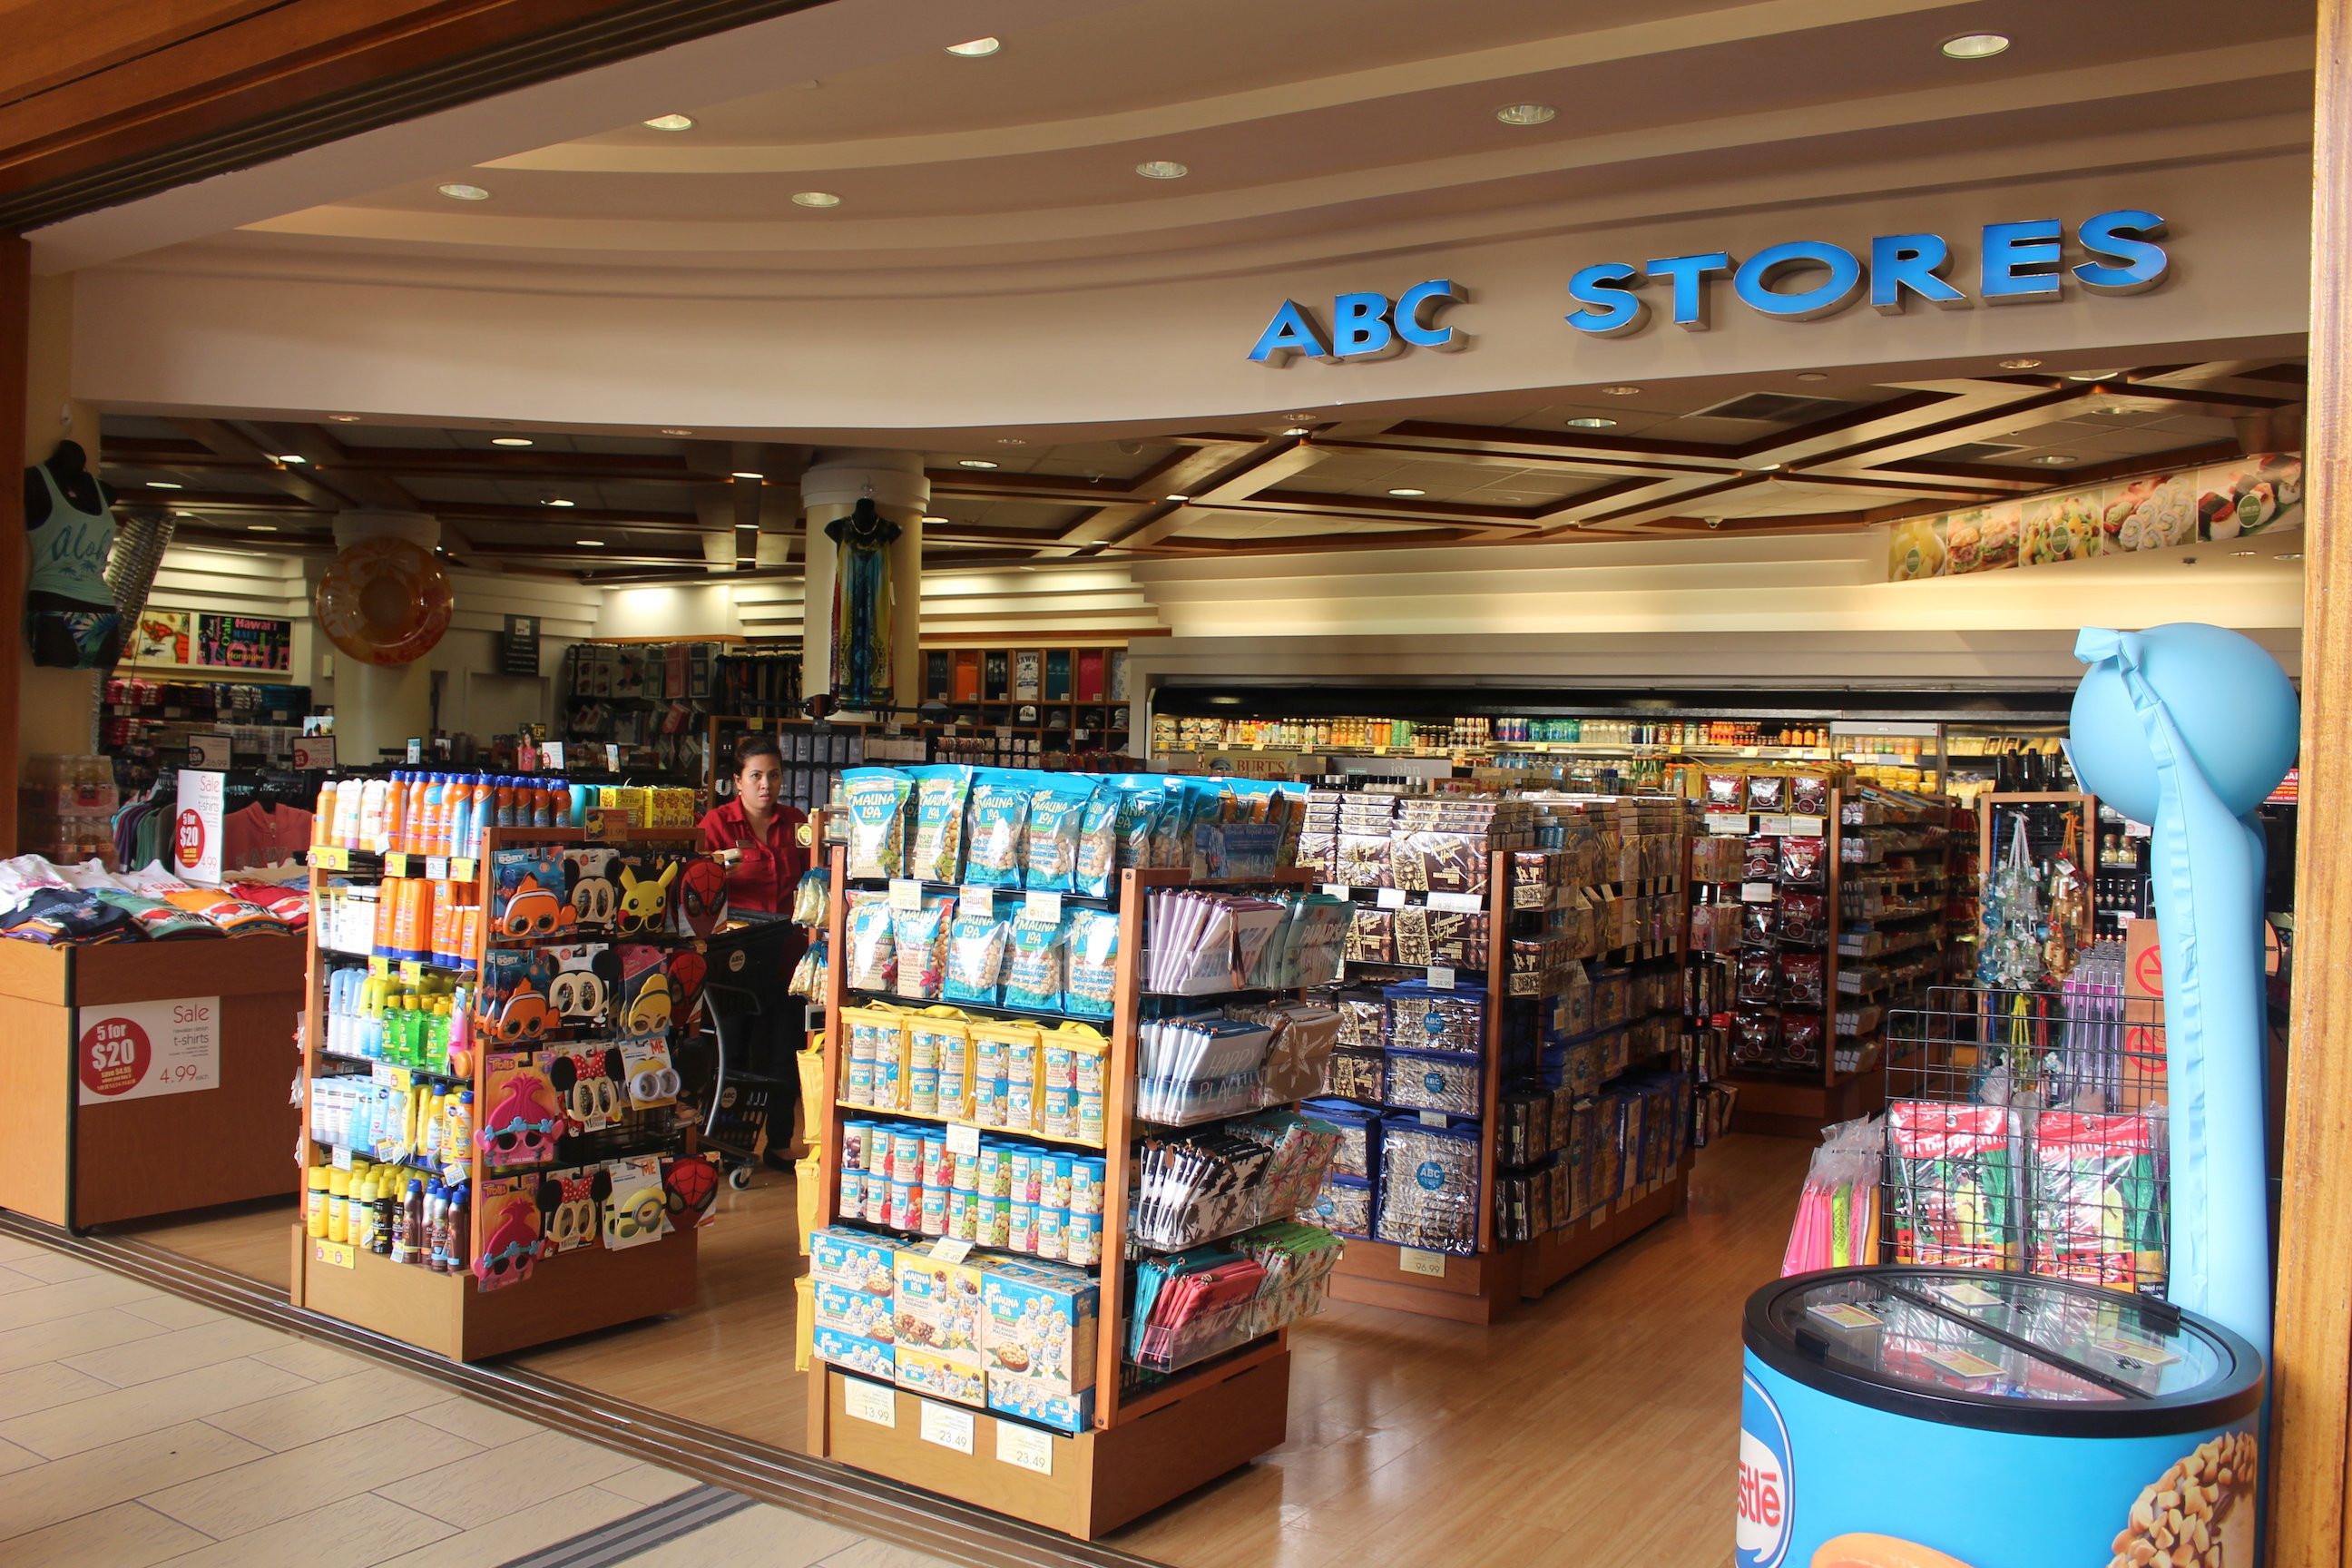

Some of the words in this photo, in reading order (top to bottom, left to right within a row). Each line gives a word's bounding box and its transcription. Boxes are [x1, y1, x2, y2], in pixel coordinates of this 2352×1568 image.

[1247, 278, 1472, 366] ABC
[1563, 210, 2171, 338] STORES
[1237, 760, 1285, 773] BURT'S
[1390, 762, 1421, 776] john
[201, 775, 220, 792] Sale
[853, 793, 895, 806] MAUNA
[922, 795, 953, 806] MAUNA
[980, 797, 1014, 808] MAUNA
[198, 800, 220, 812] t-shirts
[1033, 800, 1068, 813] MAUNA
[862, 807, 882, 818] LOA
[927, 807, 940, 819] LOA
[986, 809, 1000, 821] LOA
[1037, 811, 1054, 825] LOA
[182, 813, 187, 825] 5
[180, 827, 199, 848] $20
[201, 857, 217, 869] 4.99
[498, 854, 524, 864] DORY
[1439, 850, 1455, 864] Host
[962, 897, 986, 906] HAWAII
[902, 910, 938, 922] MAUNA
[959, 915, 995, 926] MAUNA
[1018, 920, 1057, 932] MAUNA
[1430, 914, 1465, 932] Hawaiian
[963, 925, 980, 937] LOA
[1443, 925, 1458, 938] Host
[1026, 932, 1042, 944] LOA
[496, 956, 519, 965] DORY
[173, 1004, 209, 1024] Sale
[1426, 1016, 1441, 1024] ABC
[97, 1026, 105, 1041] 5
[108, 1024, 126, 1039] for
[174, 1034, 209, 1045] t-shirts
[651, 1039, 666, 1054] ME
[92, 1039, 135, 1072] $20
[1202, 1048, 1259, 1078] HAPPY
[160, 1064, 197, 1084] 4.99
[722, 1089, 735, 1099] ABC
[1198, 1082, 1244, 1105] PLACE
[1904, 1144, 1921, 1153] FOR
[2041, 1146, 2060, 1155] FOR
[641, 1162, 657, 1177] ME
[1420, 1169, 1441, 1179] ABC
[819, 1246, 842, 1257] MAUNA
[943, 1251, 960, 1260] 5.49
[825, 1255, 837, 1264] LOA
[1416, 1262, 1440, 1273] 96.99
[904, 1270, 931, 1285] MAUNA
[910, 1280, 923, 1293] LOA
[824, 1292, 847, 1303] MAUNA
[993, 1295, 1019, 1308] MAUNA
[829, 1302, 840, 1311] LOA
[999, 1305, 1012, 1316] LOA
[826, 1338, 842, 1348] MAUNA
[863, 1406, 889, 1422] 13.99
[939, 1429, 967, 1448] 23.49
[1016, 1450, 1045, 1469] 23.49
